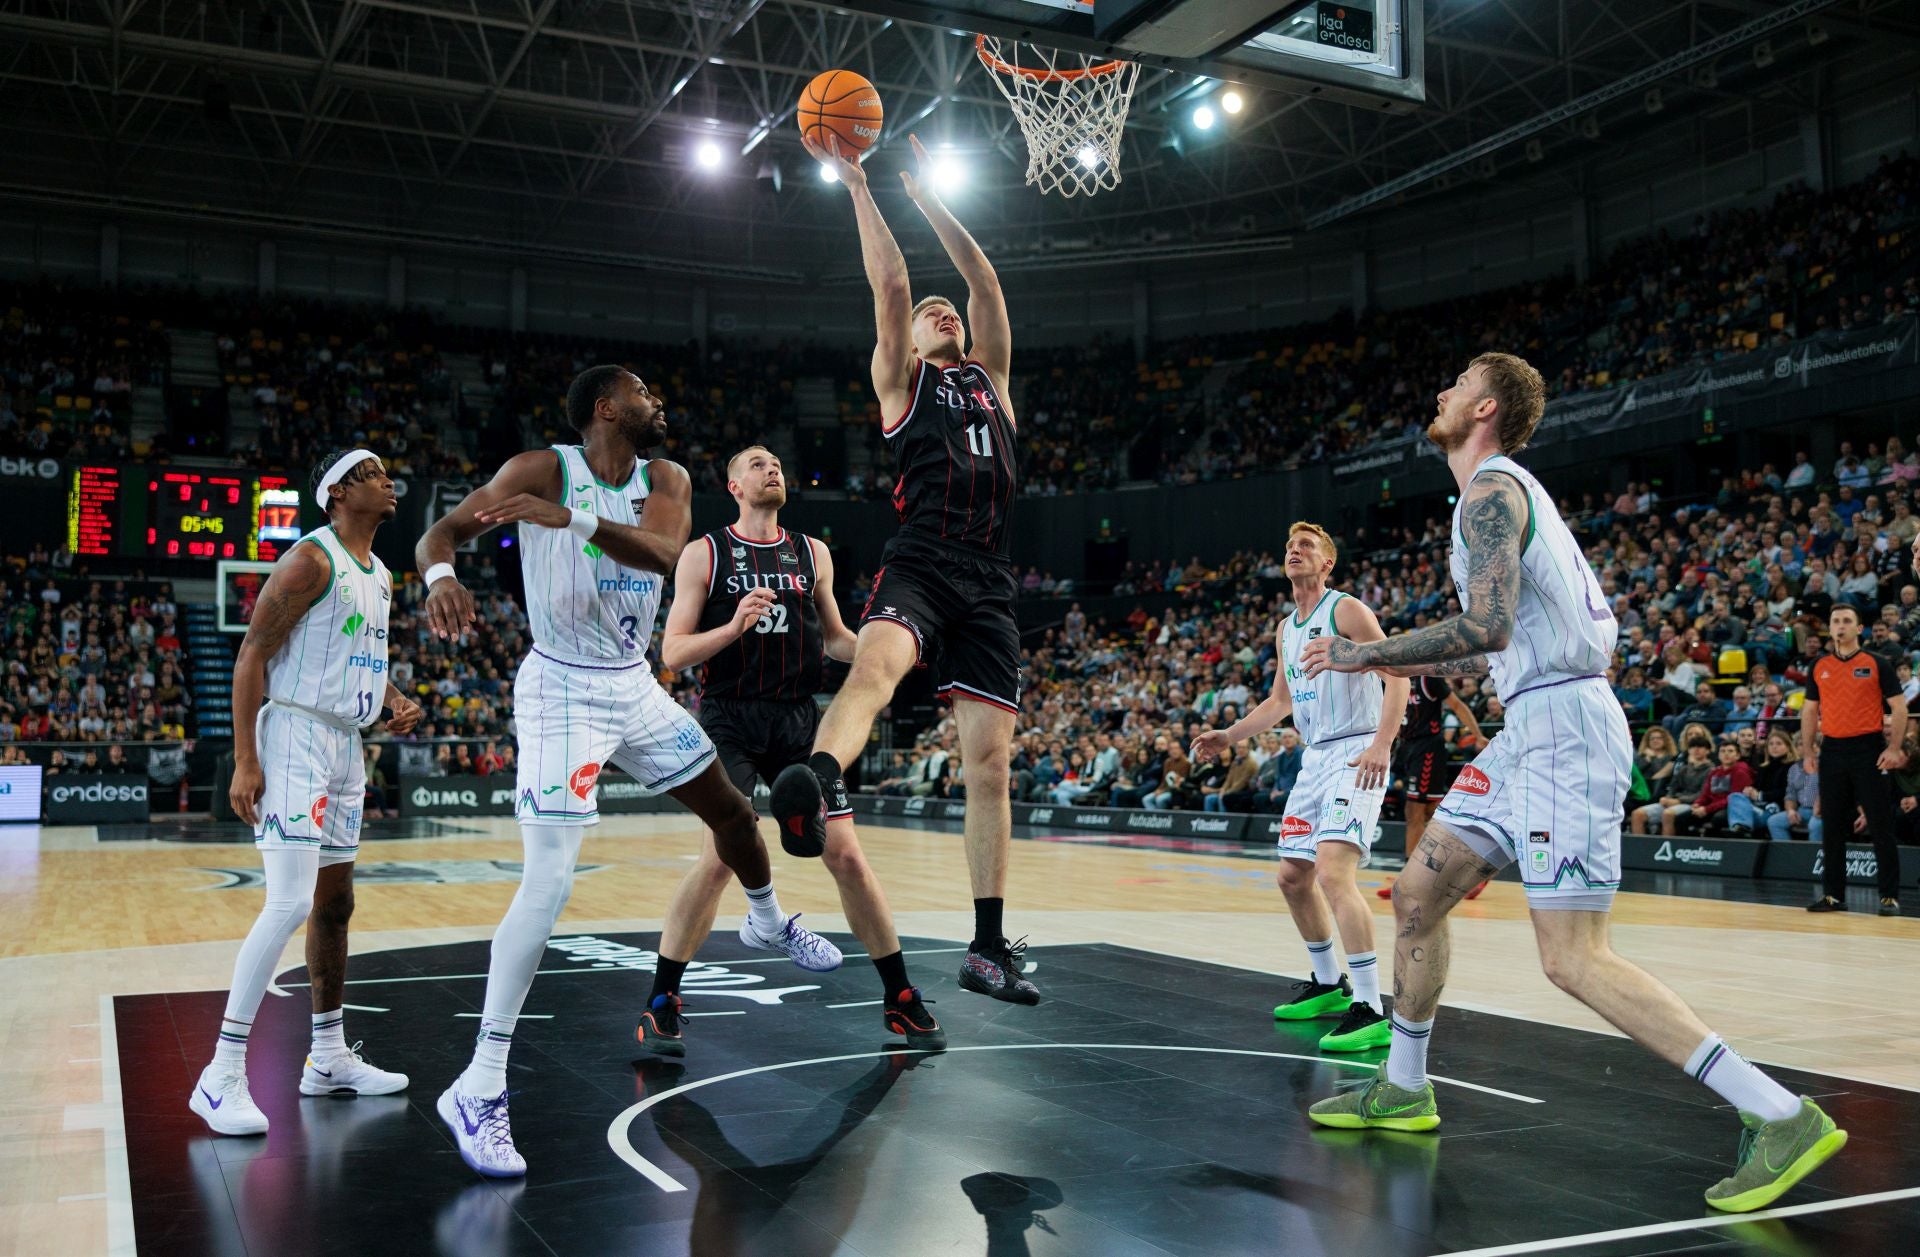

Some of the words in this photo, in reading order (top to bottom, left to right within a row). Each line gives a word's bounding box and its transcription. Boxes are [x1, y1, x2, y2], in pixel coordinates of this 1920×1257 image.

[1320, 13, 1343, 30] liga
[1320, 30, 1371, 50] endesa
[966, 424, 993, 457] 11
[180, 515, 224, 534] 05:45
[726, 572, 808, 594] surne
[619, 615, 638, 649] 3
[53, 782, 147, 802] endesa
[430, 789, 479, 808] IMQ
[1530, 834, 1546, 842] acb
